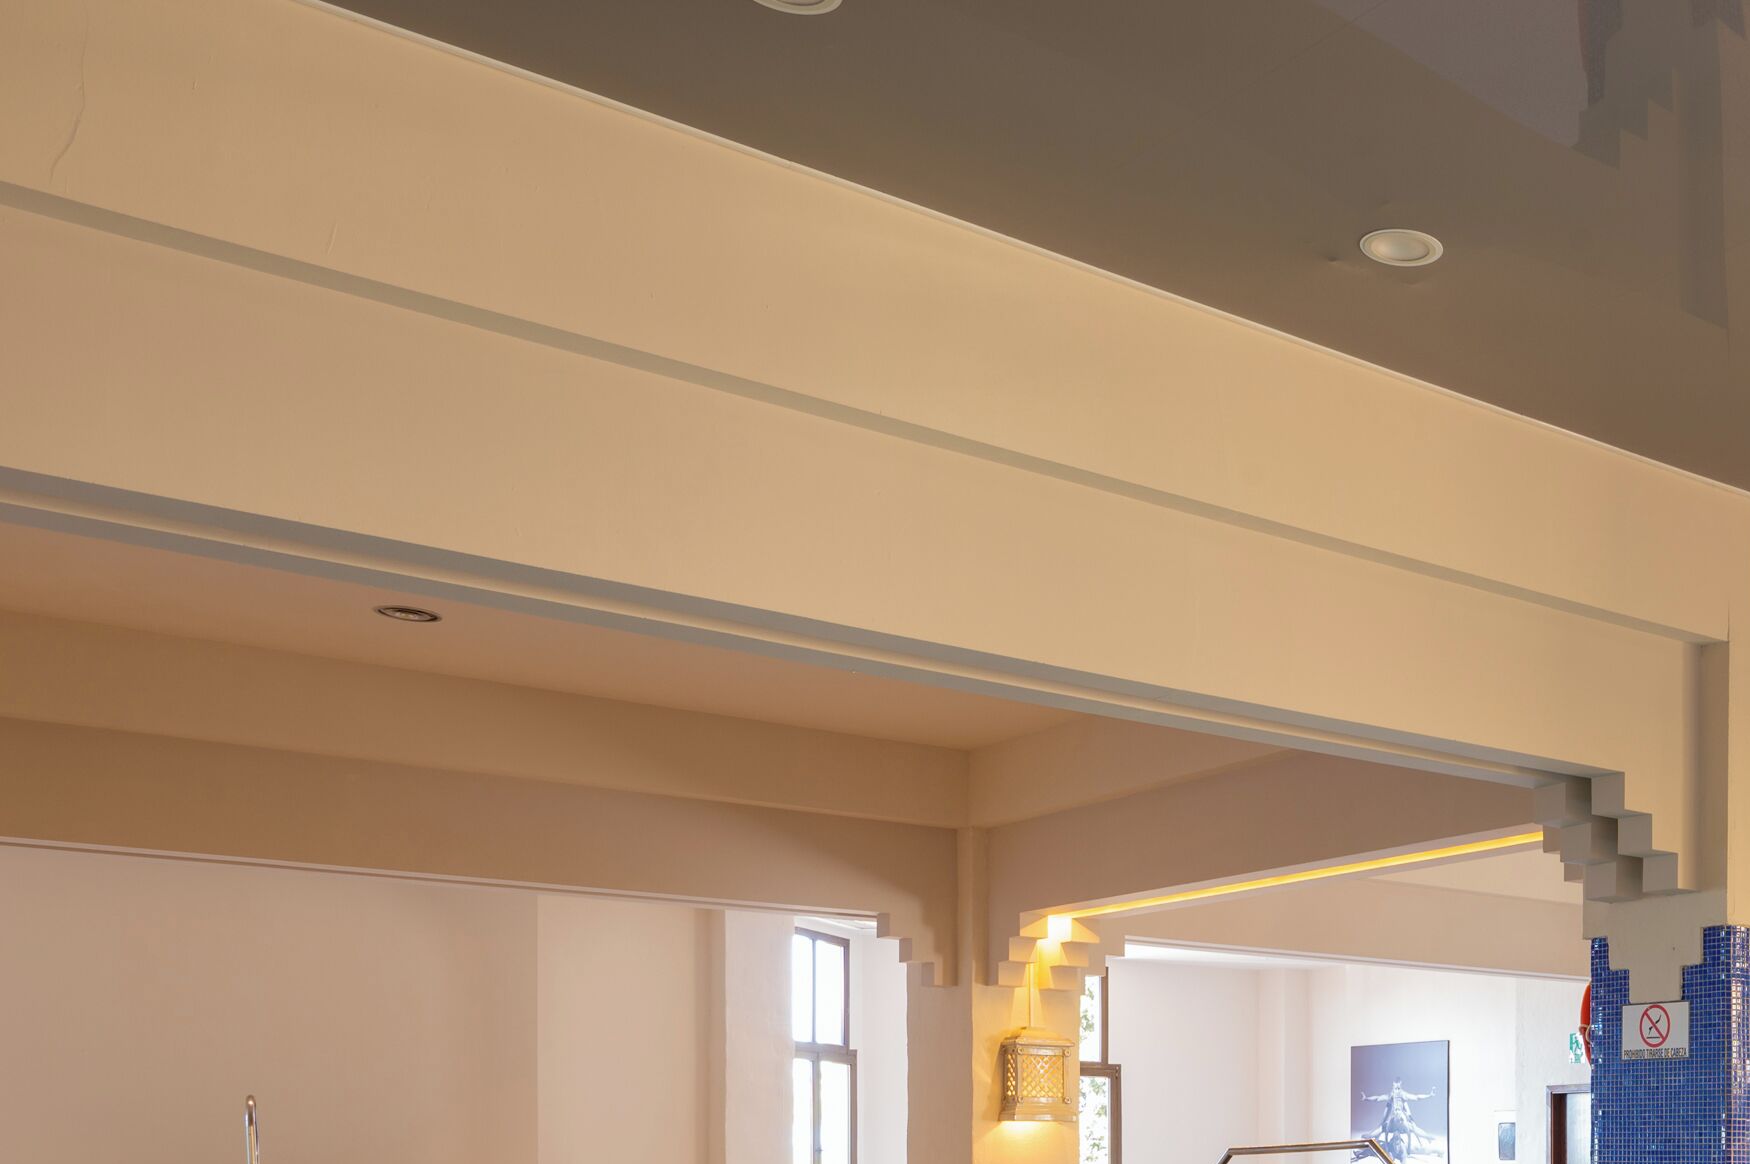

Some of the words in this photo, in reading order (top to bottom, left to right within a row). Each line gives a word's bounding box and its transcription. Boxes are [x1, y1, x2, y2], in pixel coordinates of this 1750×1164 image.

[1623, 1049, 1645, 1059] PROHIBIDO
[1646, 1048, 1663, 1058] TIRARSE
[1664, 1048, 1670, 1057] DE
[1671, 1047, 1687, 1057] CABEZA
